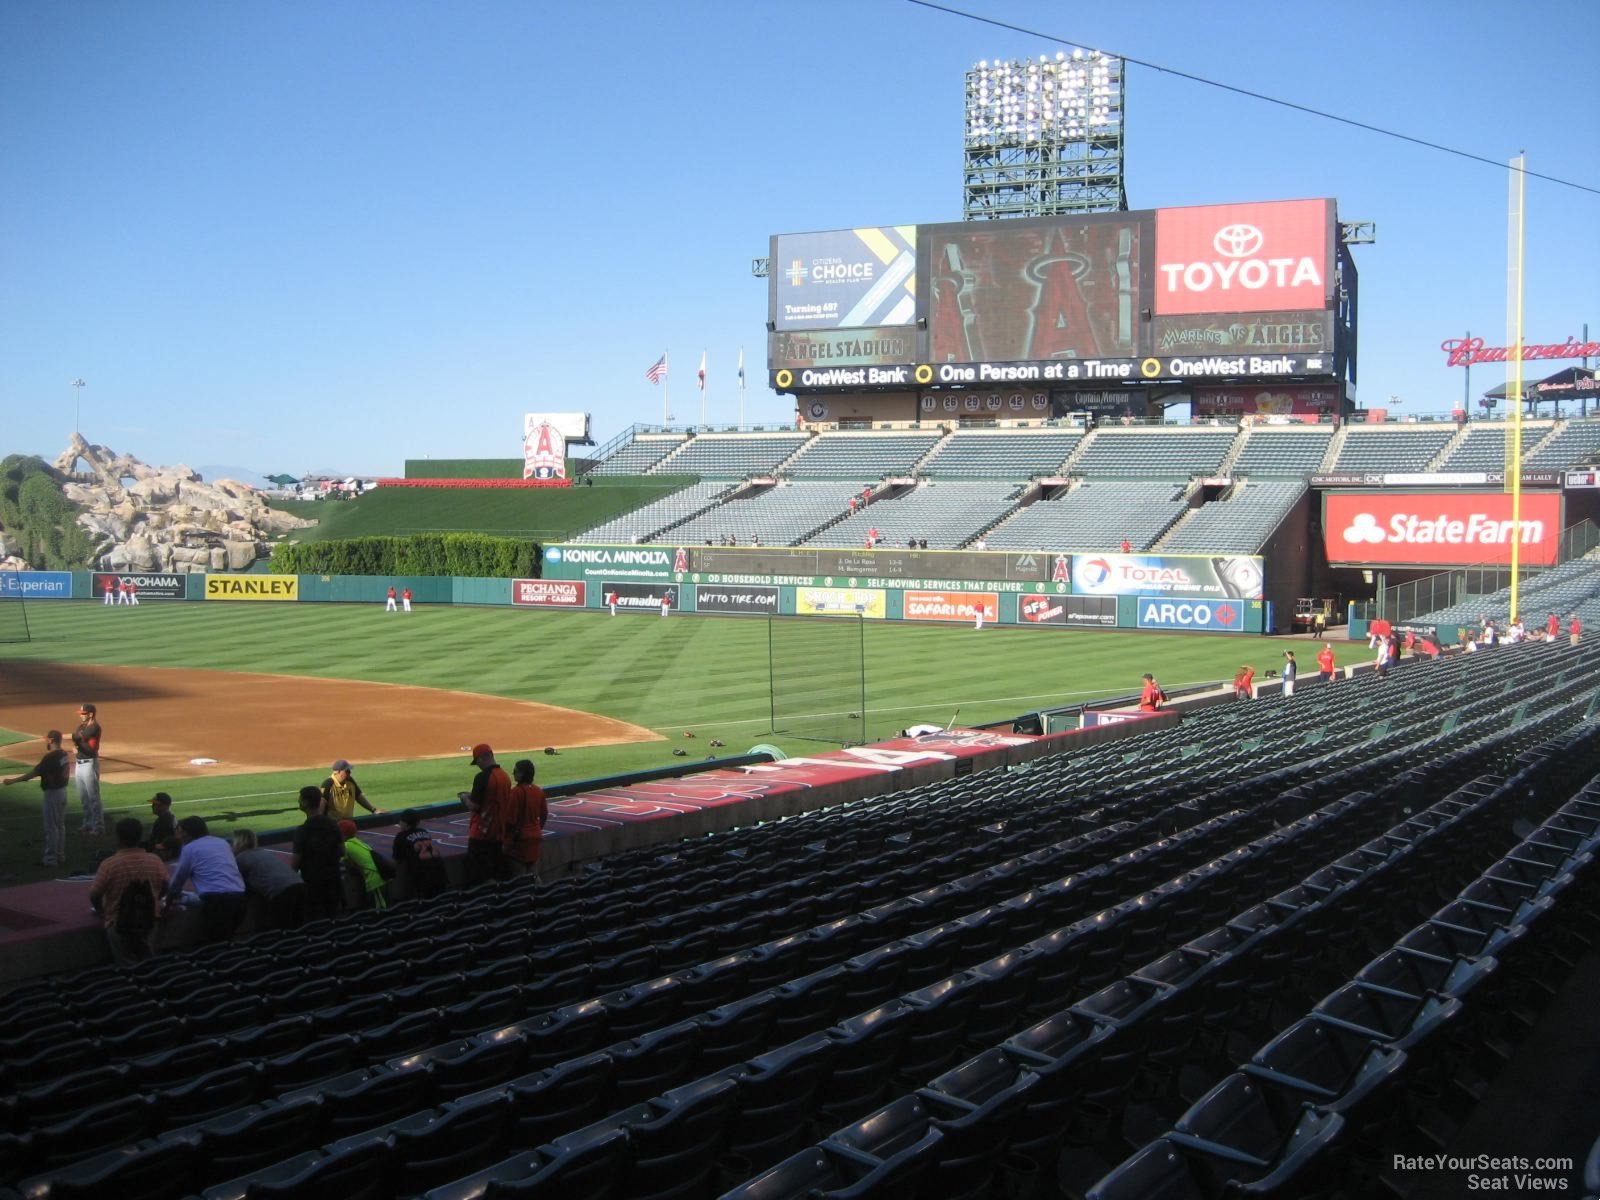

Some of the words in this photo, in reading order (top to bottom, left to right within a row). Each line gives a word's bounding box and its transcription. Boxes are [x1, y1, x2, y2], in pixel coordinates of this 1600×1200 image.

[813, 263, 872, 279] CHOICE
[1160, 257, 1321, 292] TOYOTA
[785, 304, 821, 313] Turning
[1160, 328, 1222, 347] MARLINS
[1229, 328, 1246, 340] VS
[1251, 322, 1322, 345] ANGELS
[785, 340, 833, 360] ANGEL
[836, 339, 904, 358] STADIUM
[940, 365, 975, 381] One
[980, 364, 1038, 380] Person
[1044, 364, 1063, 378] at
[1067, 366, 1078, 377] a
[1084, 361, 1131, 377] Time
[1170, 358, 1245, 375] OneWest
[1250, 356, 1293, 374] Bank
[802, 369, 865, 386] OneWest
[869, 367, 905, 383] Bank
[925, 398, 932, 407] 11
[945, 398, 956, 406] 26
[989, 397, 1000, 405] 30
[1010, 397, 1022, 405] 42
[1034, 396, 1045, 405] 50
[1101, 392, 1129, 404] Morgan
[1388, 513, 1465, 543] State
[1466, 514, 1543, 543] Farm
[563, 549, 611, 563] KONICA
[614, 551, 670, 564] MINOLTA
[708, 575, 720, 583] OD
[722, 575, 771, 584] HOUSEHOLD
[773, 576, 814, 586] SERVICES
[1119, 566, 1189, 582] TOTAL
[9, 578, 63, 591] Experian
[118, 576, 179, 587] YOKOHAMA
[208, 580, 295, 594] STANLEY
[868, 578, 920, 589] SELF-MOVING
[923, 580, 960, 591] SERVICES
[963, 582, 985, 591] THAT
[521, 583, 577, 594] PECHANGA
[521, 594, 546, 602] RESORT
[604, 592, 664, 606] Termador
[699, 593, 728, 603] NITTO
[730, 594, 776, 605] TIRE.COM
[909, 603, 955, 615] SAFARI
[957, 604, 993, 617] PAK
[1024, 601, 1047, 614] aFe
[1038, 605, 1063, 621] POWER
[1144, 604, 1211, 625] ARCO
